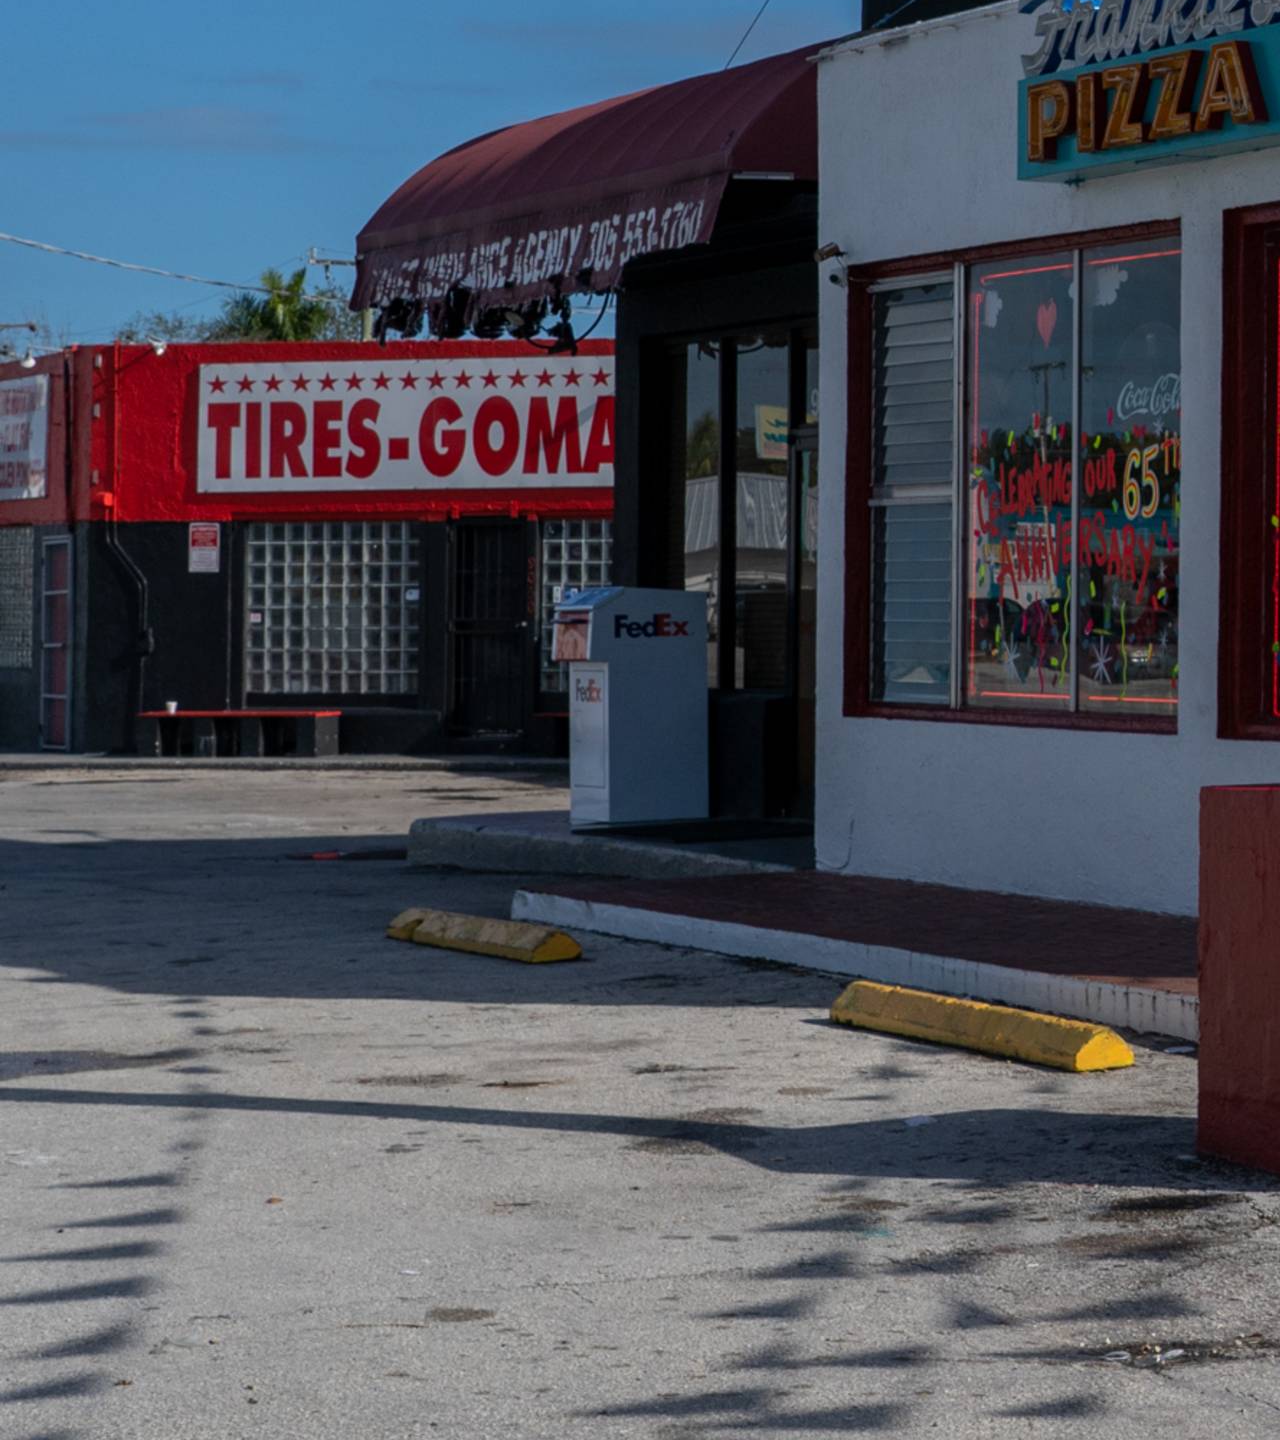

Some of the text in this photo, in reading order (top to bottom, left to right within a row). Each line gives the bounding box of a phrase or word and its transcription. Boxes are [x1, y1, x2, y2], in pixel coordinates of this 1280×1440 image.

[1027, 40, 1267, 162] PIZZA
[207, 395, 616, 479] TIRES-GOMA
[1084, 448, 1116, 496] OUR
[614, 613, 689, 639] FedEx
